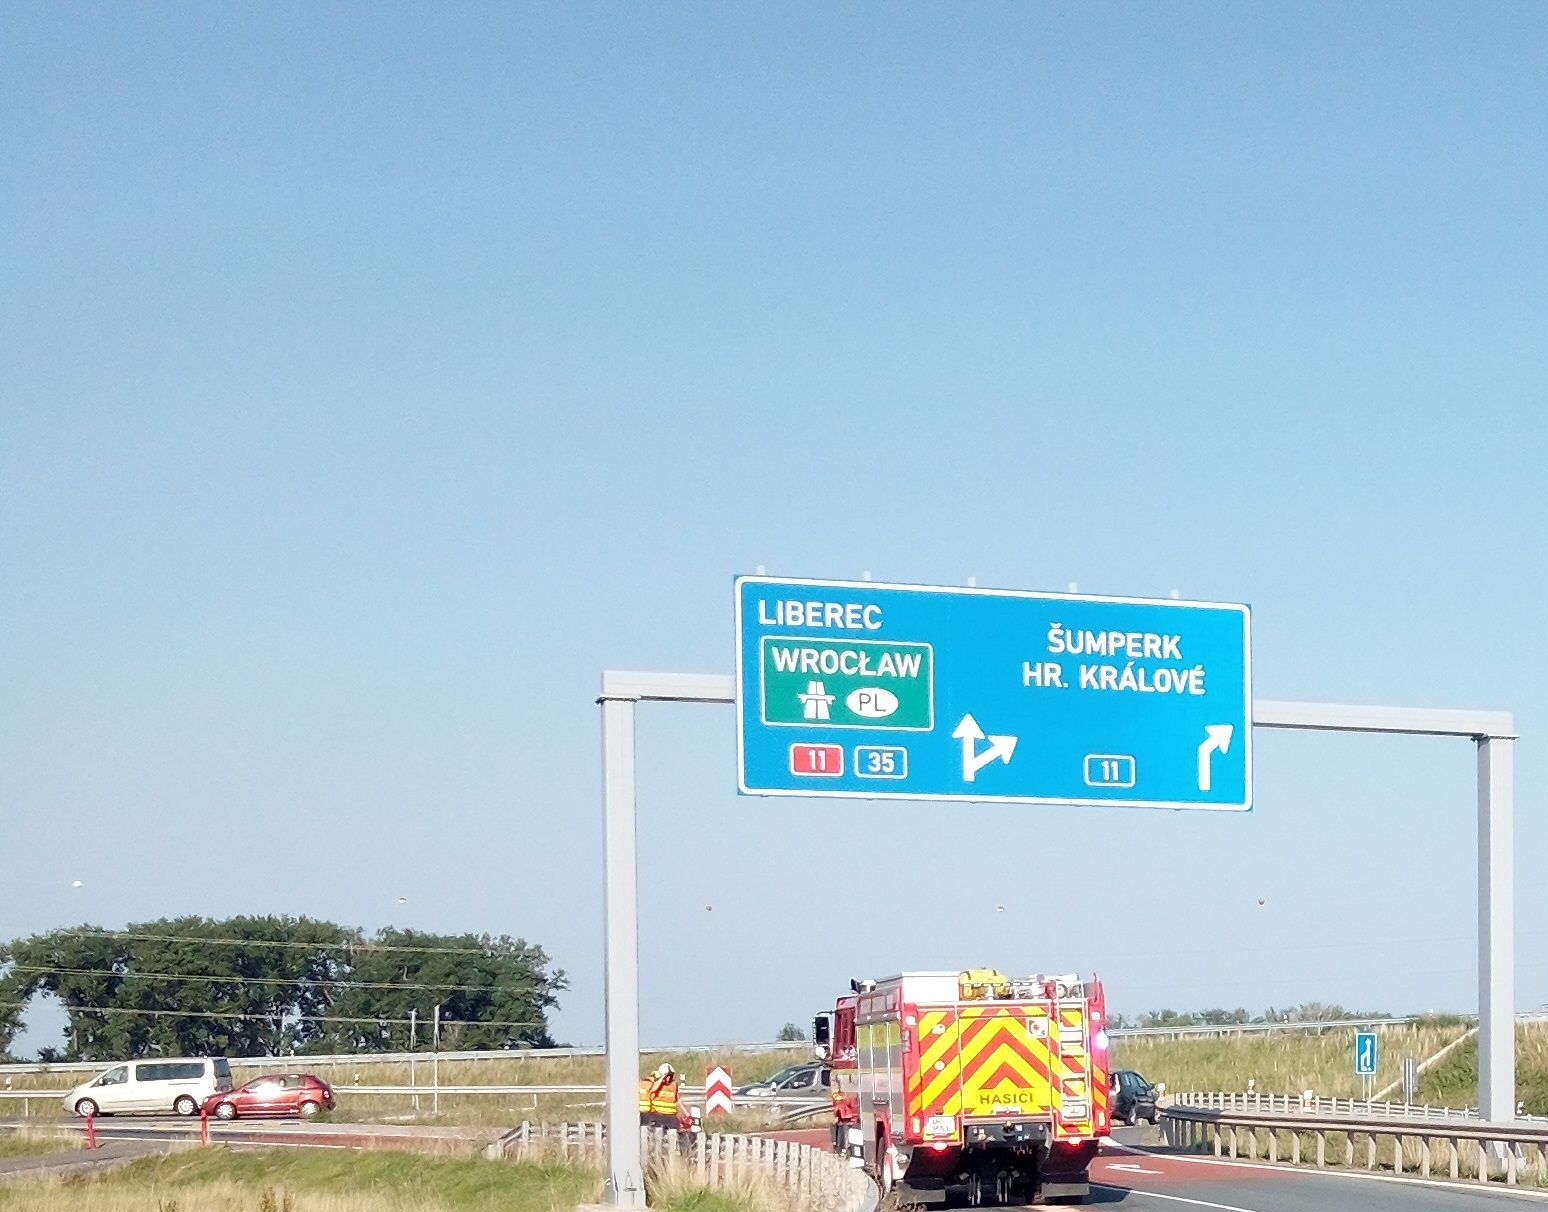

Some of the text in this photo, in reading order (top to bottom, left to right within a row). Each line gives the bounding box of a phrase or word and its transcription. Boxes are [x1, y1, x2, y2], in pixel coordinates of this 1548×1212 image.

[758, 599, 883, 630] LIBEREC
[1047, 622, 1183, 660] ŠUMPERK
[771, 646, 921, 679] WROCŁAW
[1023, 661, 1206, 696] HR. KRÁLOVÉ
[858, 693, 886, 713] PL
[807, 749, 827, 771] 11
[868, 751, 895, 774] 35
[1101, 760, 1119, 781] 11
